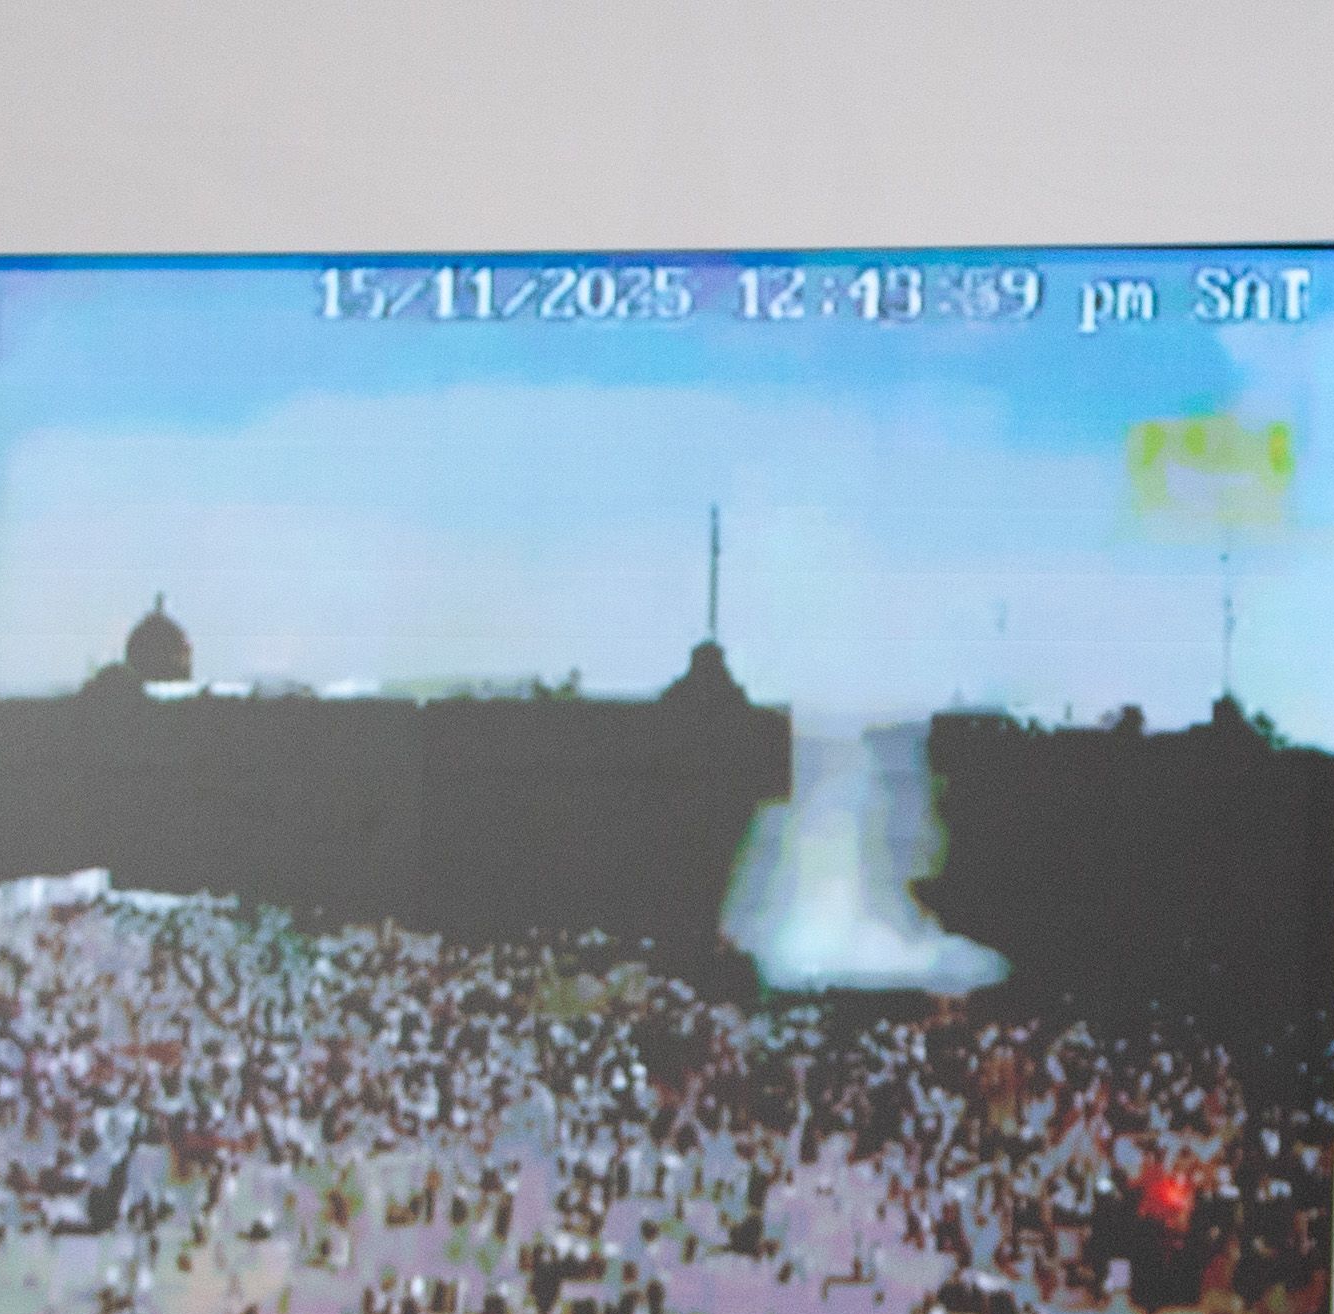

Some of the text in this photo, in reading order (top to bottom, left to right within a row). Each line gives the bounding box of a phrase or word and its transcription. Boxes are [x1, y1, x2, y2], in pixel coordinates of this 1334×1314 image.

[320, 266, 693, 319] 15/11/2025
[1079, 280, 1153, 333] pm
[1194, 266, 1312, 321] SAT
